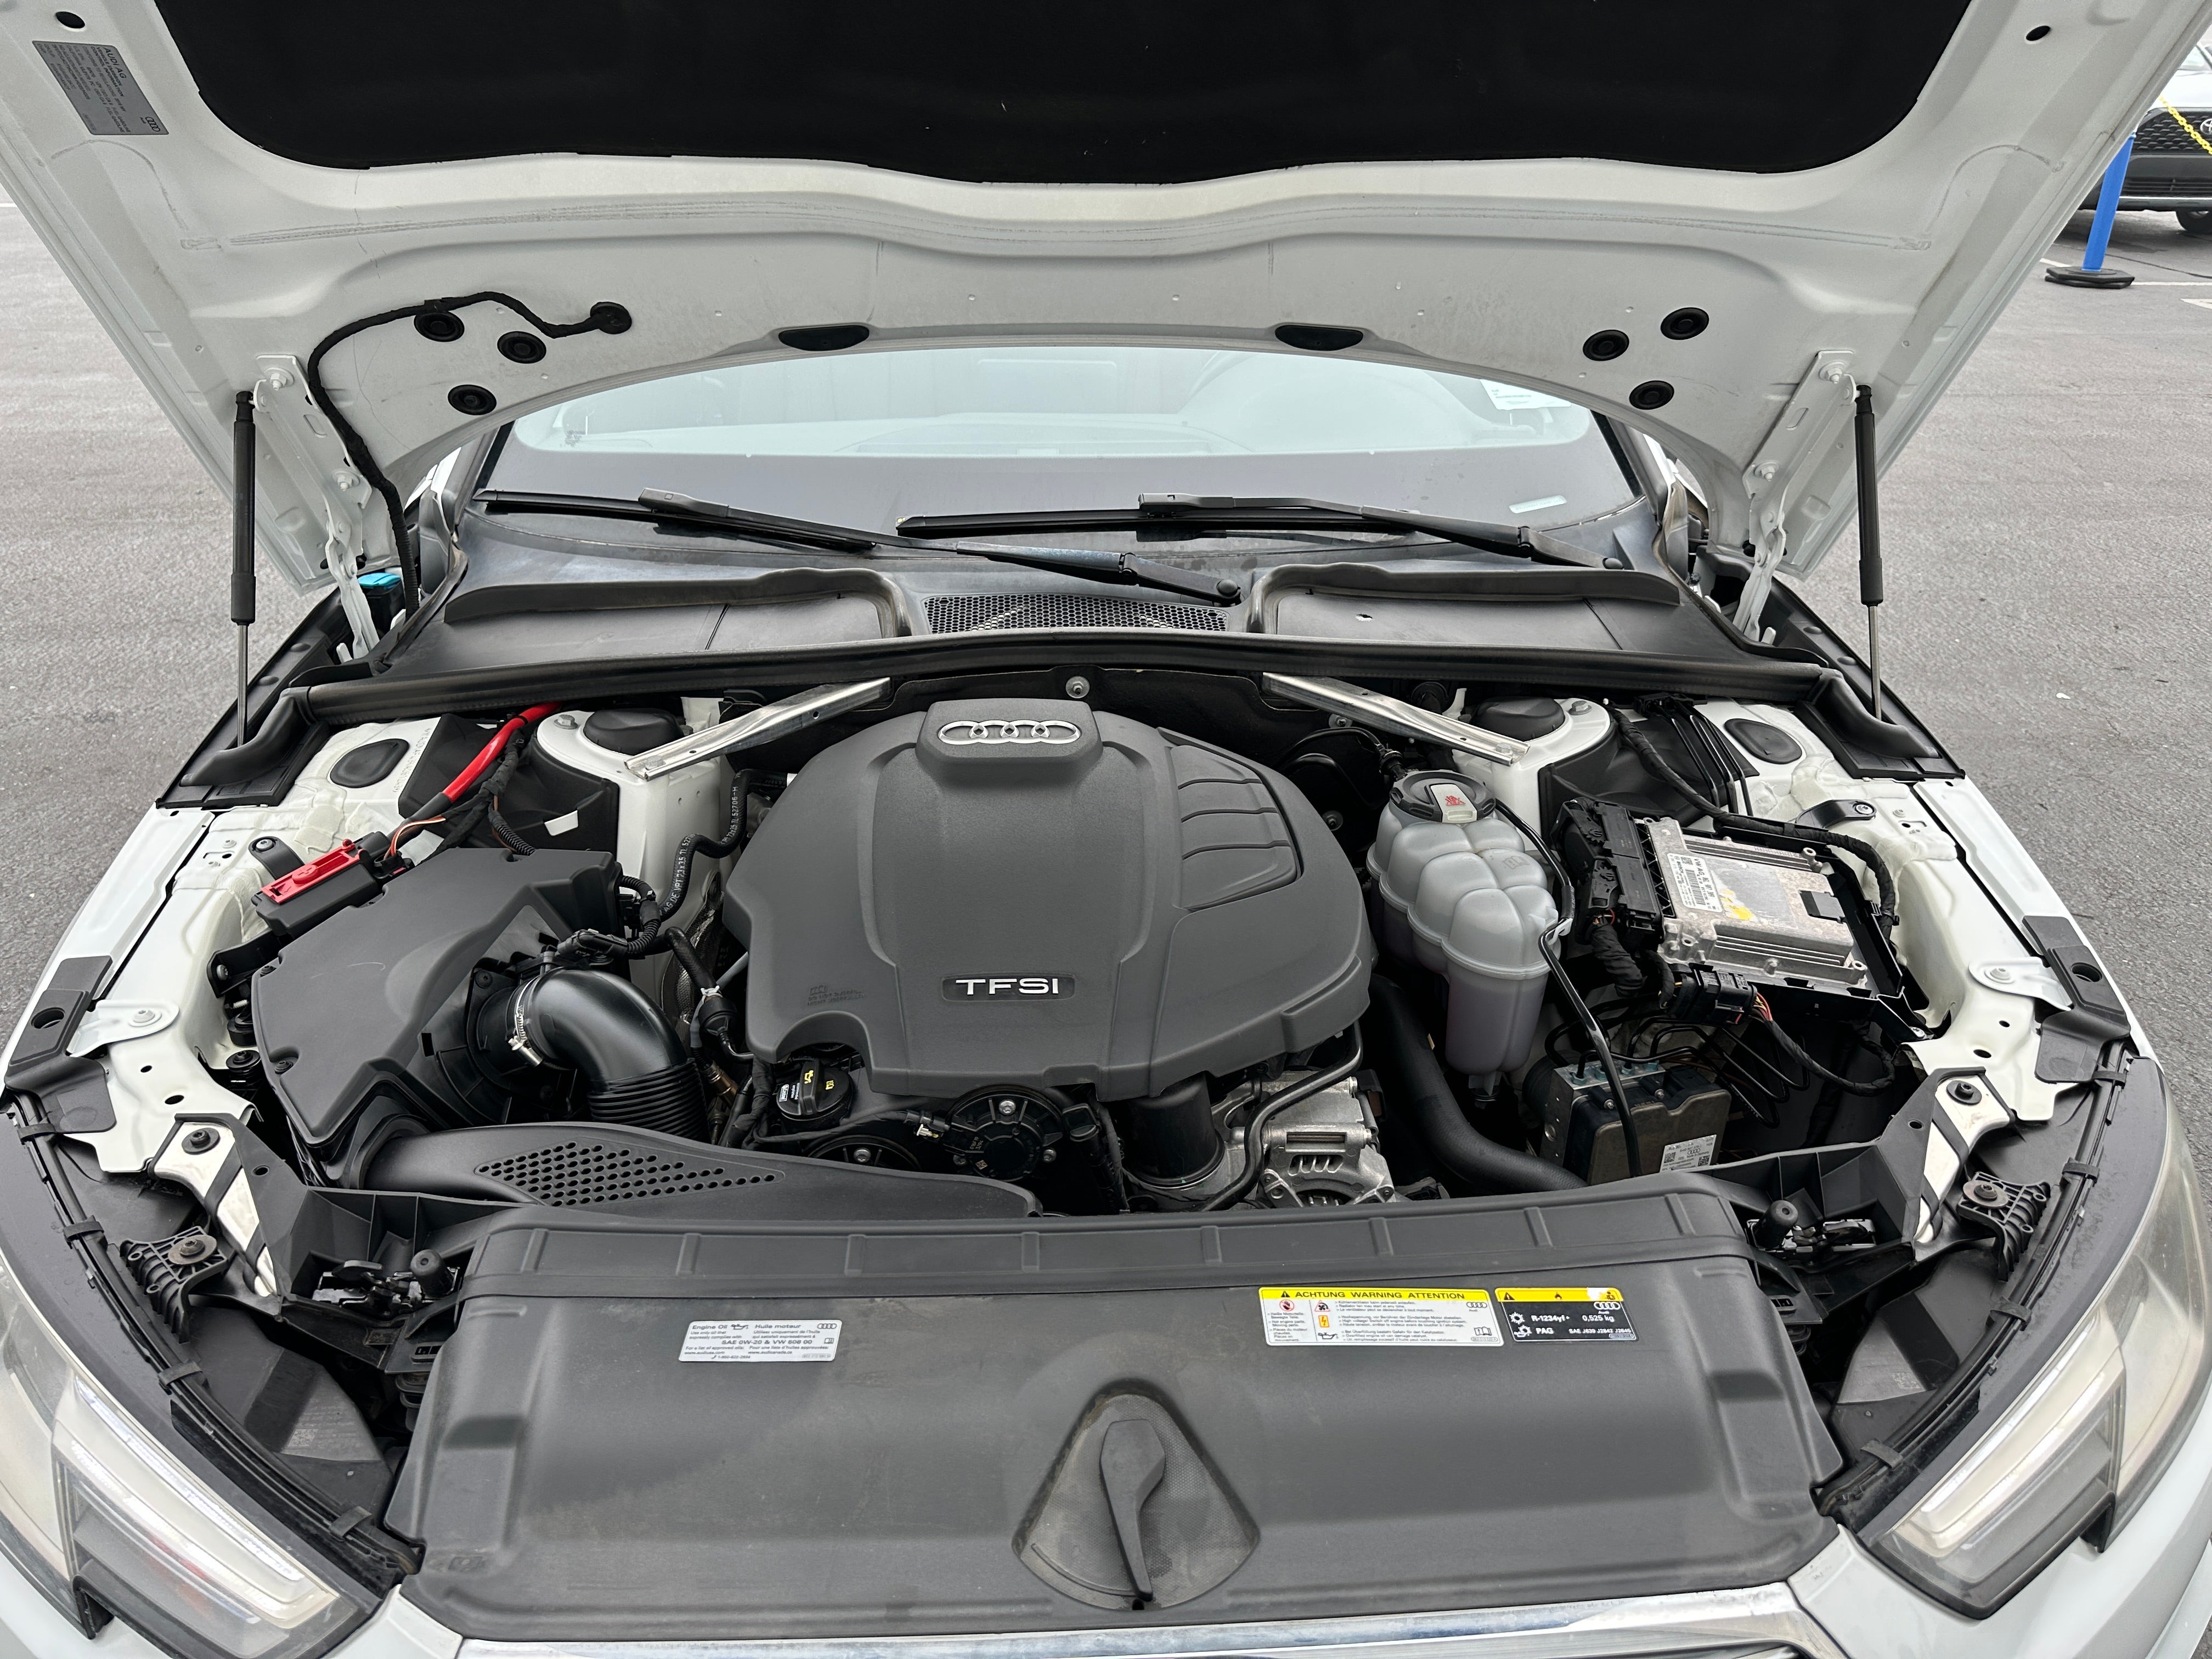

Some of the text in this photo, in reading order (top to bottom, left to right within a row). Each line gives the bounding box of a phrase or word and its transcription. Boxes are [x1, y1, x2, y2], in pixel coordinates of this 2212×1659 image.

[102, 47, 127, 78] AUDI AG
[89, 46, 125, 96] CONTROL INFORMATION
[674, 878, 684, 891] VPT
[670, 892, 680, 904] DE
[663, 902, 673, 912] AG
[956, 978, 1059, 995] TFSI
